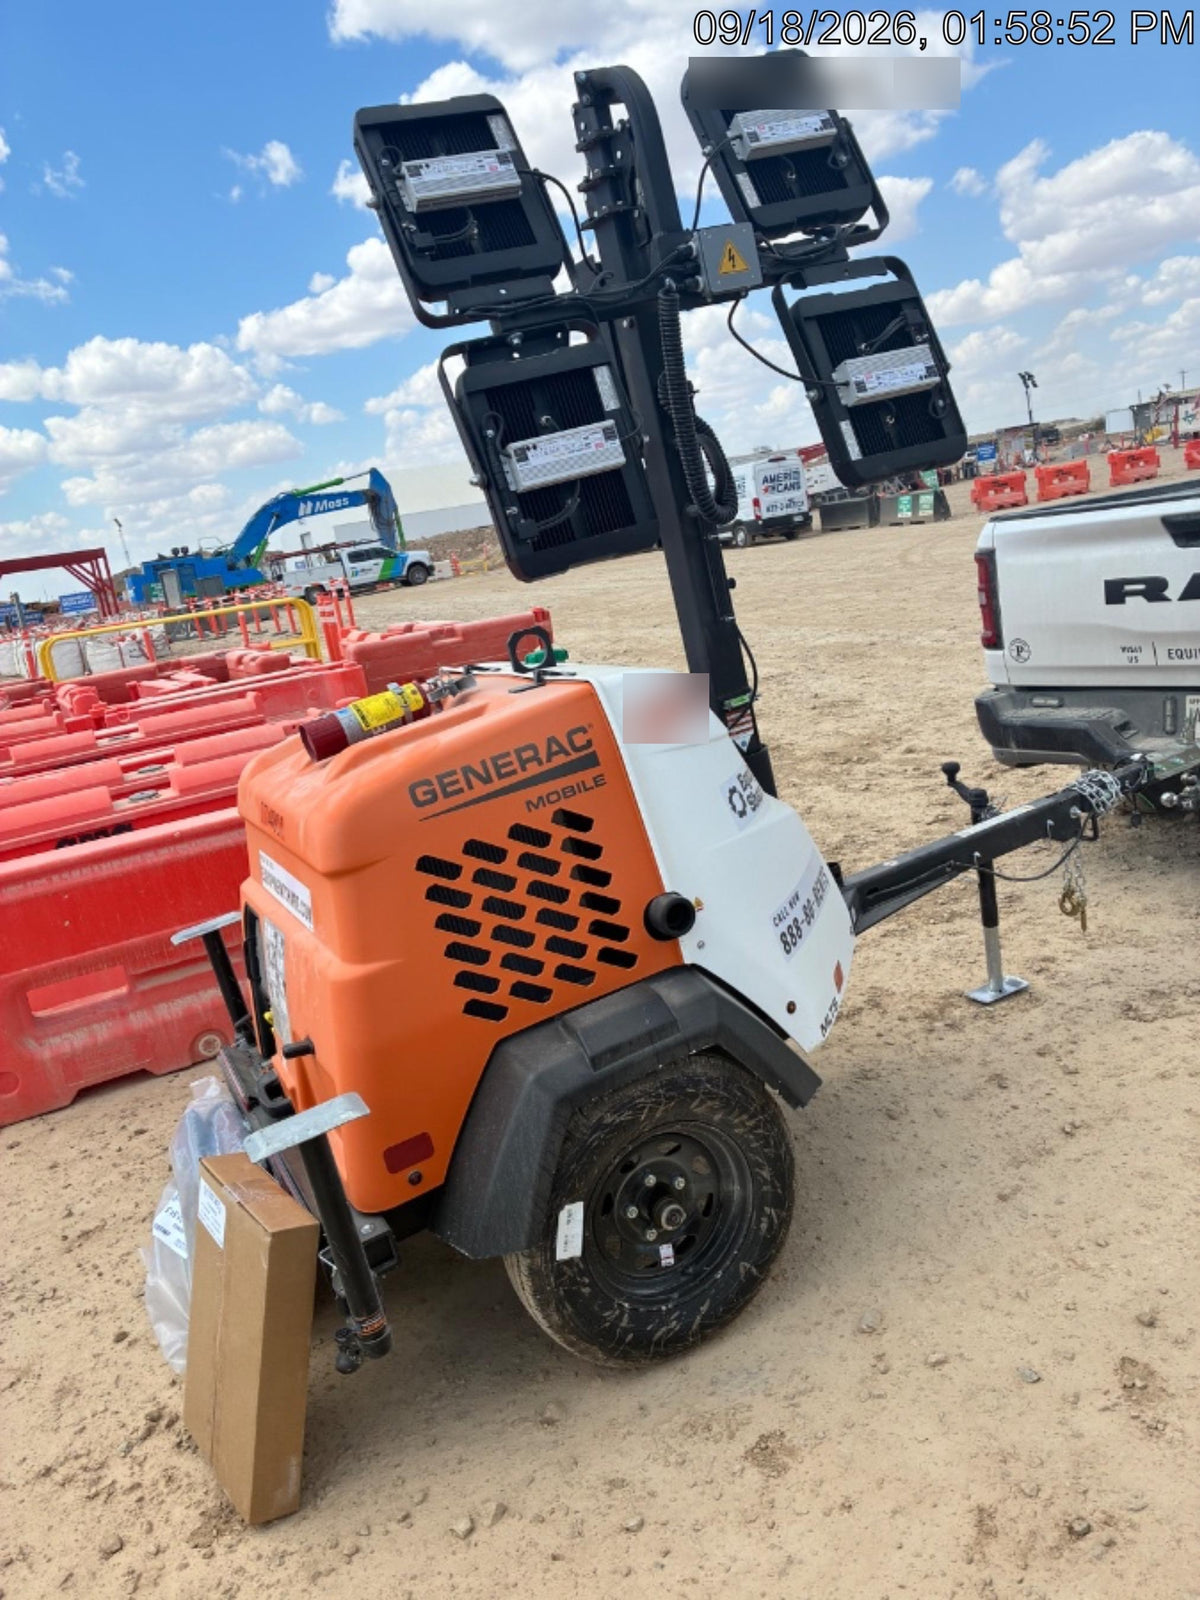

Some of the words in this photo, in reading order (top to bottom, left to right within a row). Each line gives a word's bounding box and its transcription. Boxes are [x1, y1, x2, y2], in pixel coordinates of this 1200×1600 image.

[762, 472, 791, 484] AMERI
[314, 497, 350, 513] Moss
[1127, 655, 1140, 664] US
[1167, 648, 1200, 660] EQUI
[408, 724, 594, 809] GENERAC
[525, 773, 607, 813] MOBILE
[772, 906, 790, 928] CALL
